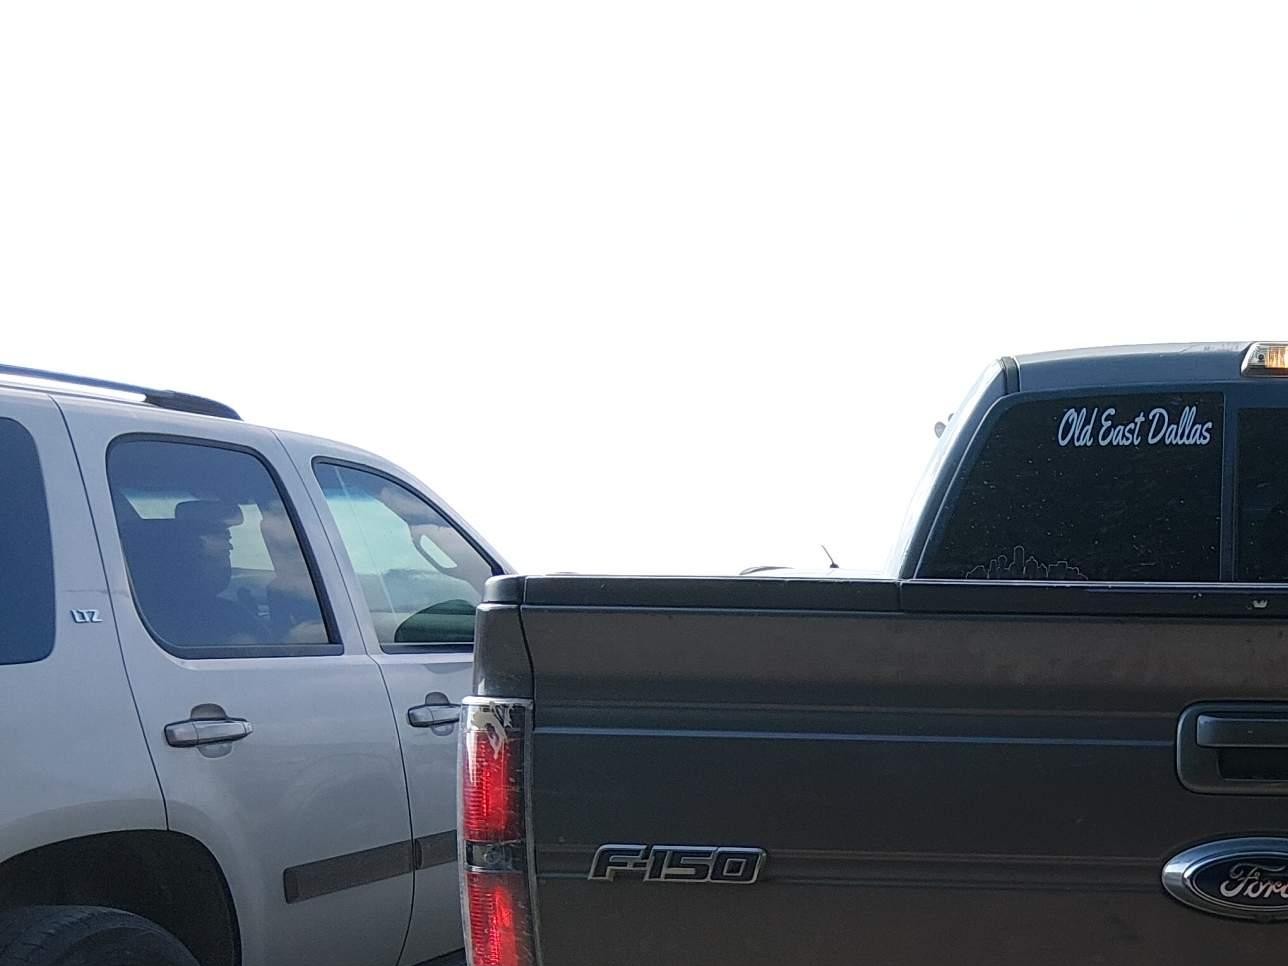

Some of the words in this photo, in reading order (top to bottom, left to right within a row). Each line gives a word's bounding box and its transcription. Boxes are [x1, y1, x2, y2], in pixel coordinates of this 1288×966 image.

[1058, 406, 1099, 447] Old
[1098, 407, 1146, 447] East
[1148, 405, 1213, 446] Dallas
[70, 608, 104, 624] LTZ
[587, 843, 768, 885] F-150
